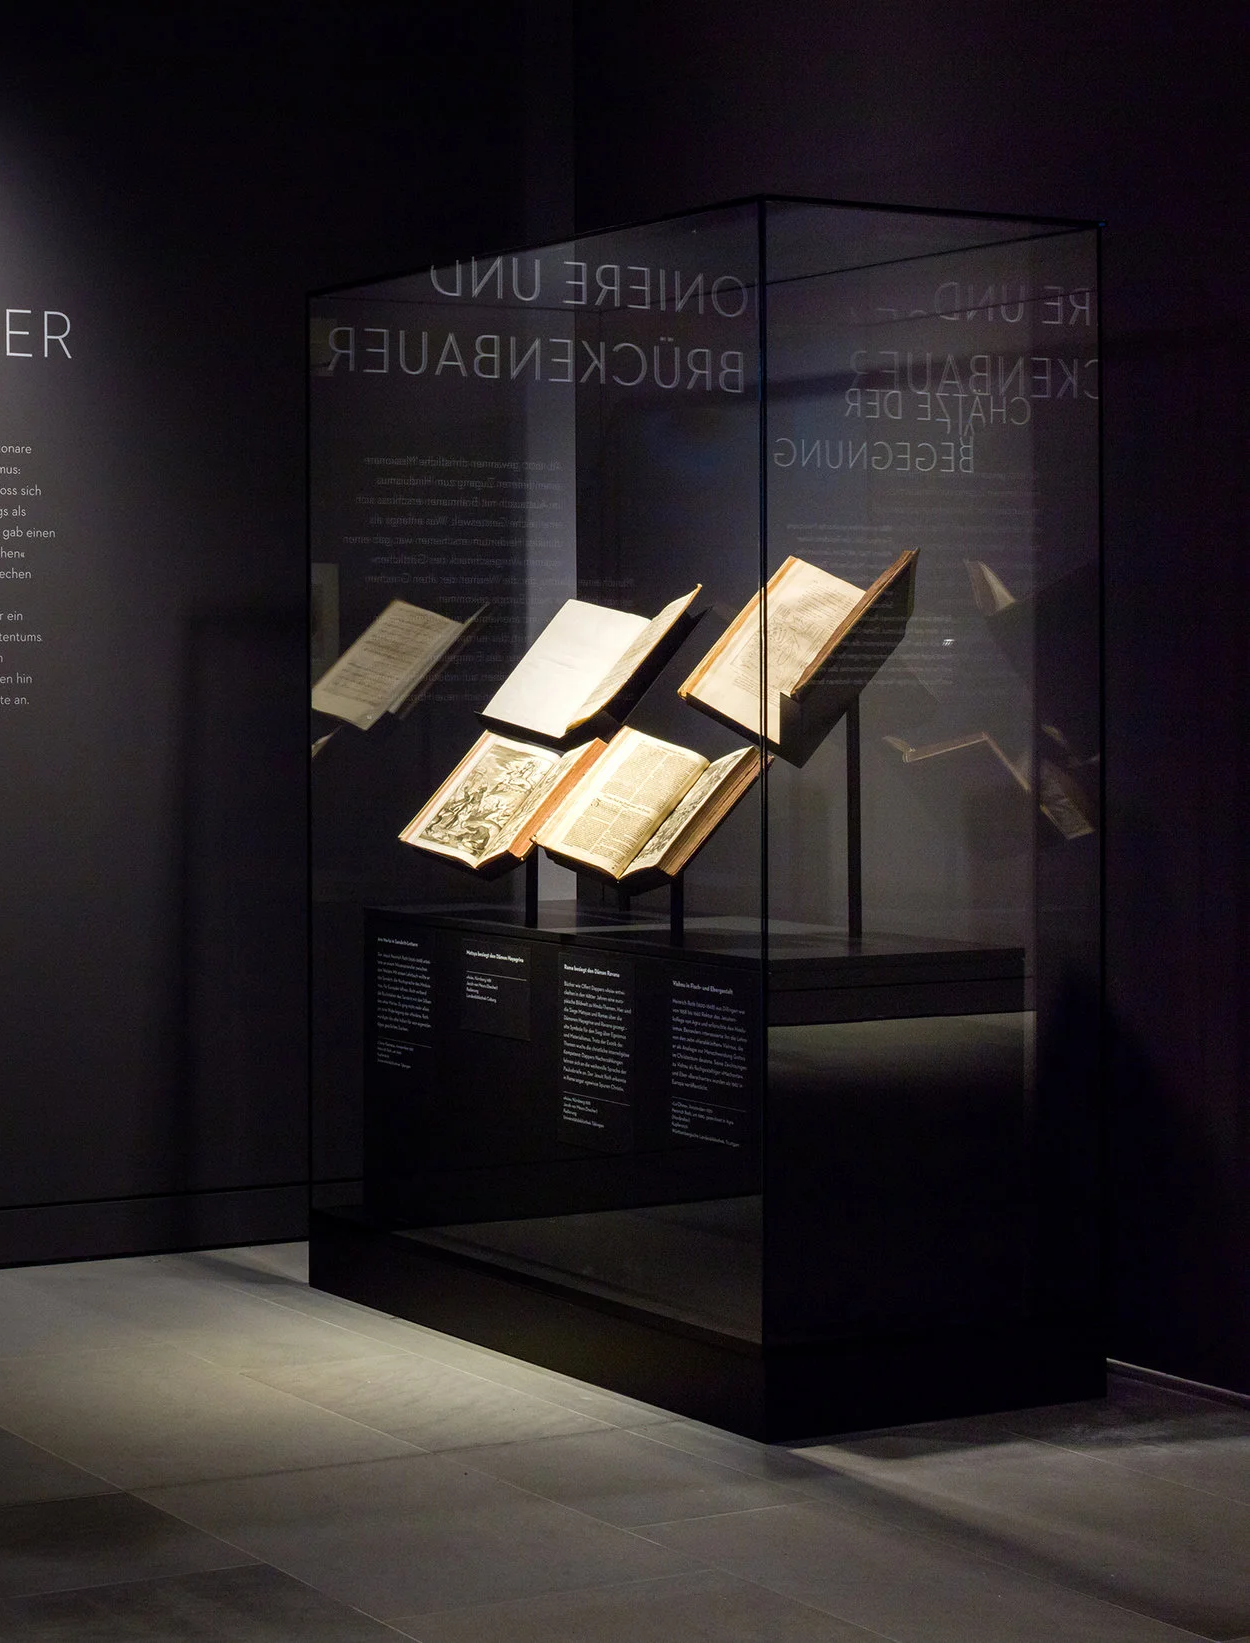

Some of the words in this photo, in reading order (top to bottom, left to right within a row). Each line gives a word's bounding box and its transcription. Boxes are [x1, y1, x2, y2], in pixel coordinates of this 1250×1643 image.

[20, 484, 41, 496] sich
[11, 504, 26, 517] als
[2, 525, 23, 540] gab
[26, 527, 55, 538] einen
[6, 610, 23, 621] ein
[16, 672, 32, 683] hin
[14, 696, 29, 705] an.
